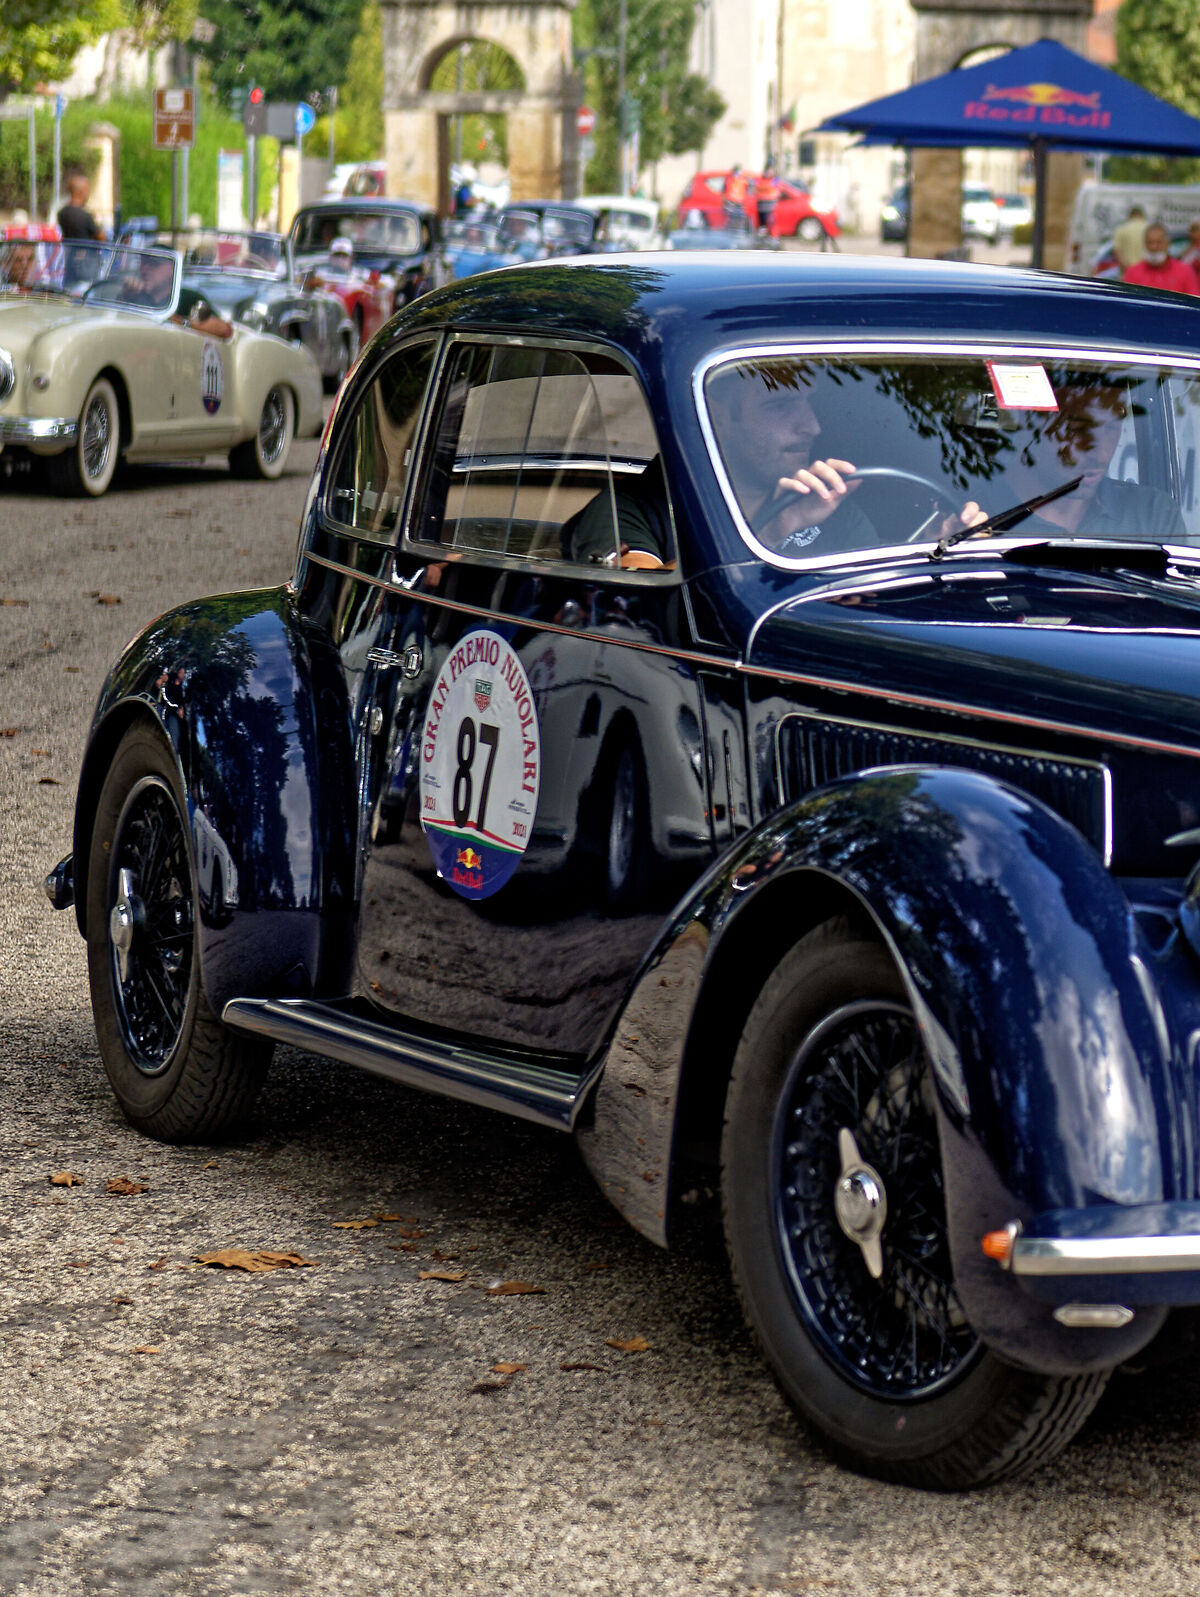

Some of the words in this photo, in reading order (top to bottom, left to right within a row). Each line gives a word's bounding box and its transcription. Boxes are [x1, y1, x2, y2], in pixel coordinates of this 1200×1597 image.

[964, 101, 1036, 123] Red
[1040, 106, 1111, 130] Bull
[421, 677, 450, 763] GRAN
[449, 637, 500, 683] PREMIO
[500, 652, 538, 794] NUVOLARI
[452, 716, 500, 832] 87
